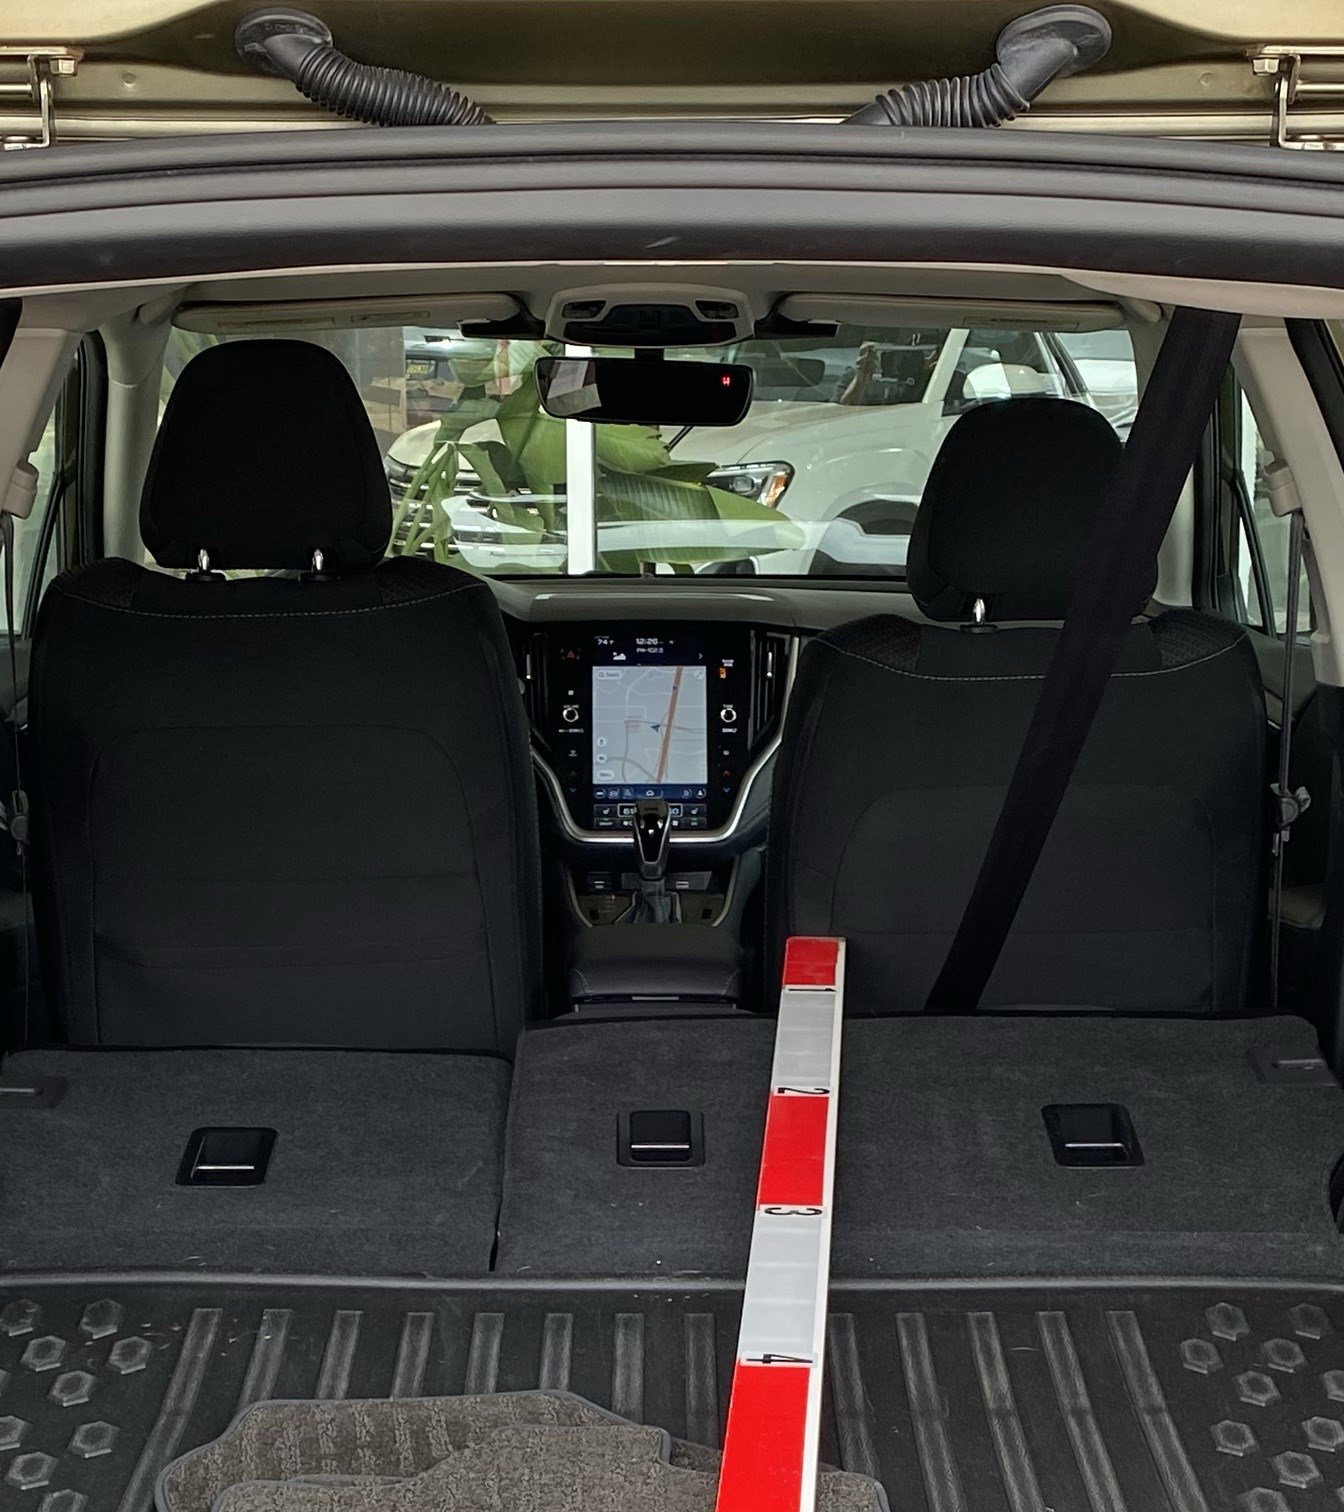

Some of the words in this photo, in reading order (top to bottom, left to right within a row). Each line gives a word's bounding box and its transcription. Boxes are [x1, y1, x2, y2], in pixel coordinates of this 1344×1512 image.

[777, 1087, 830, 1095] 2
[764, 1207, 823, 1216] 3
[746, 1353, 813, 1364] 4
